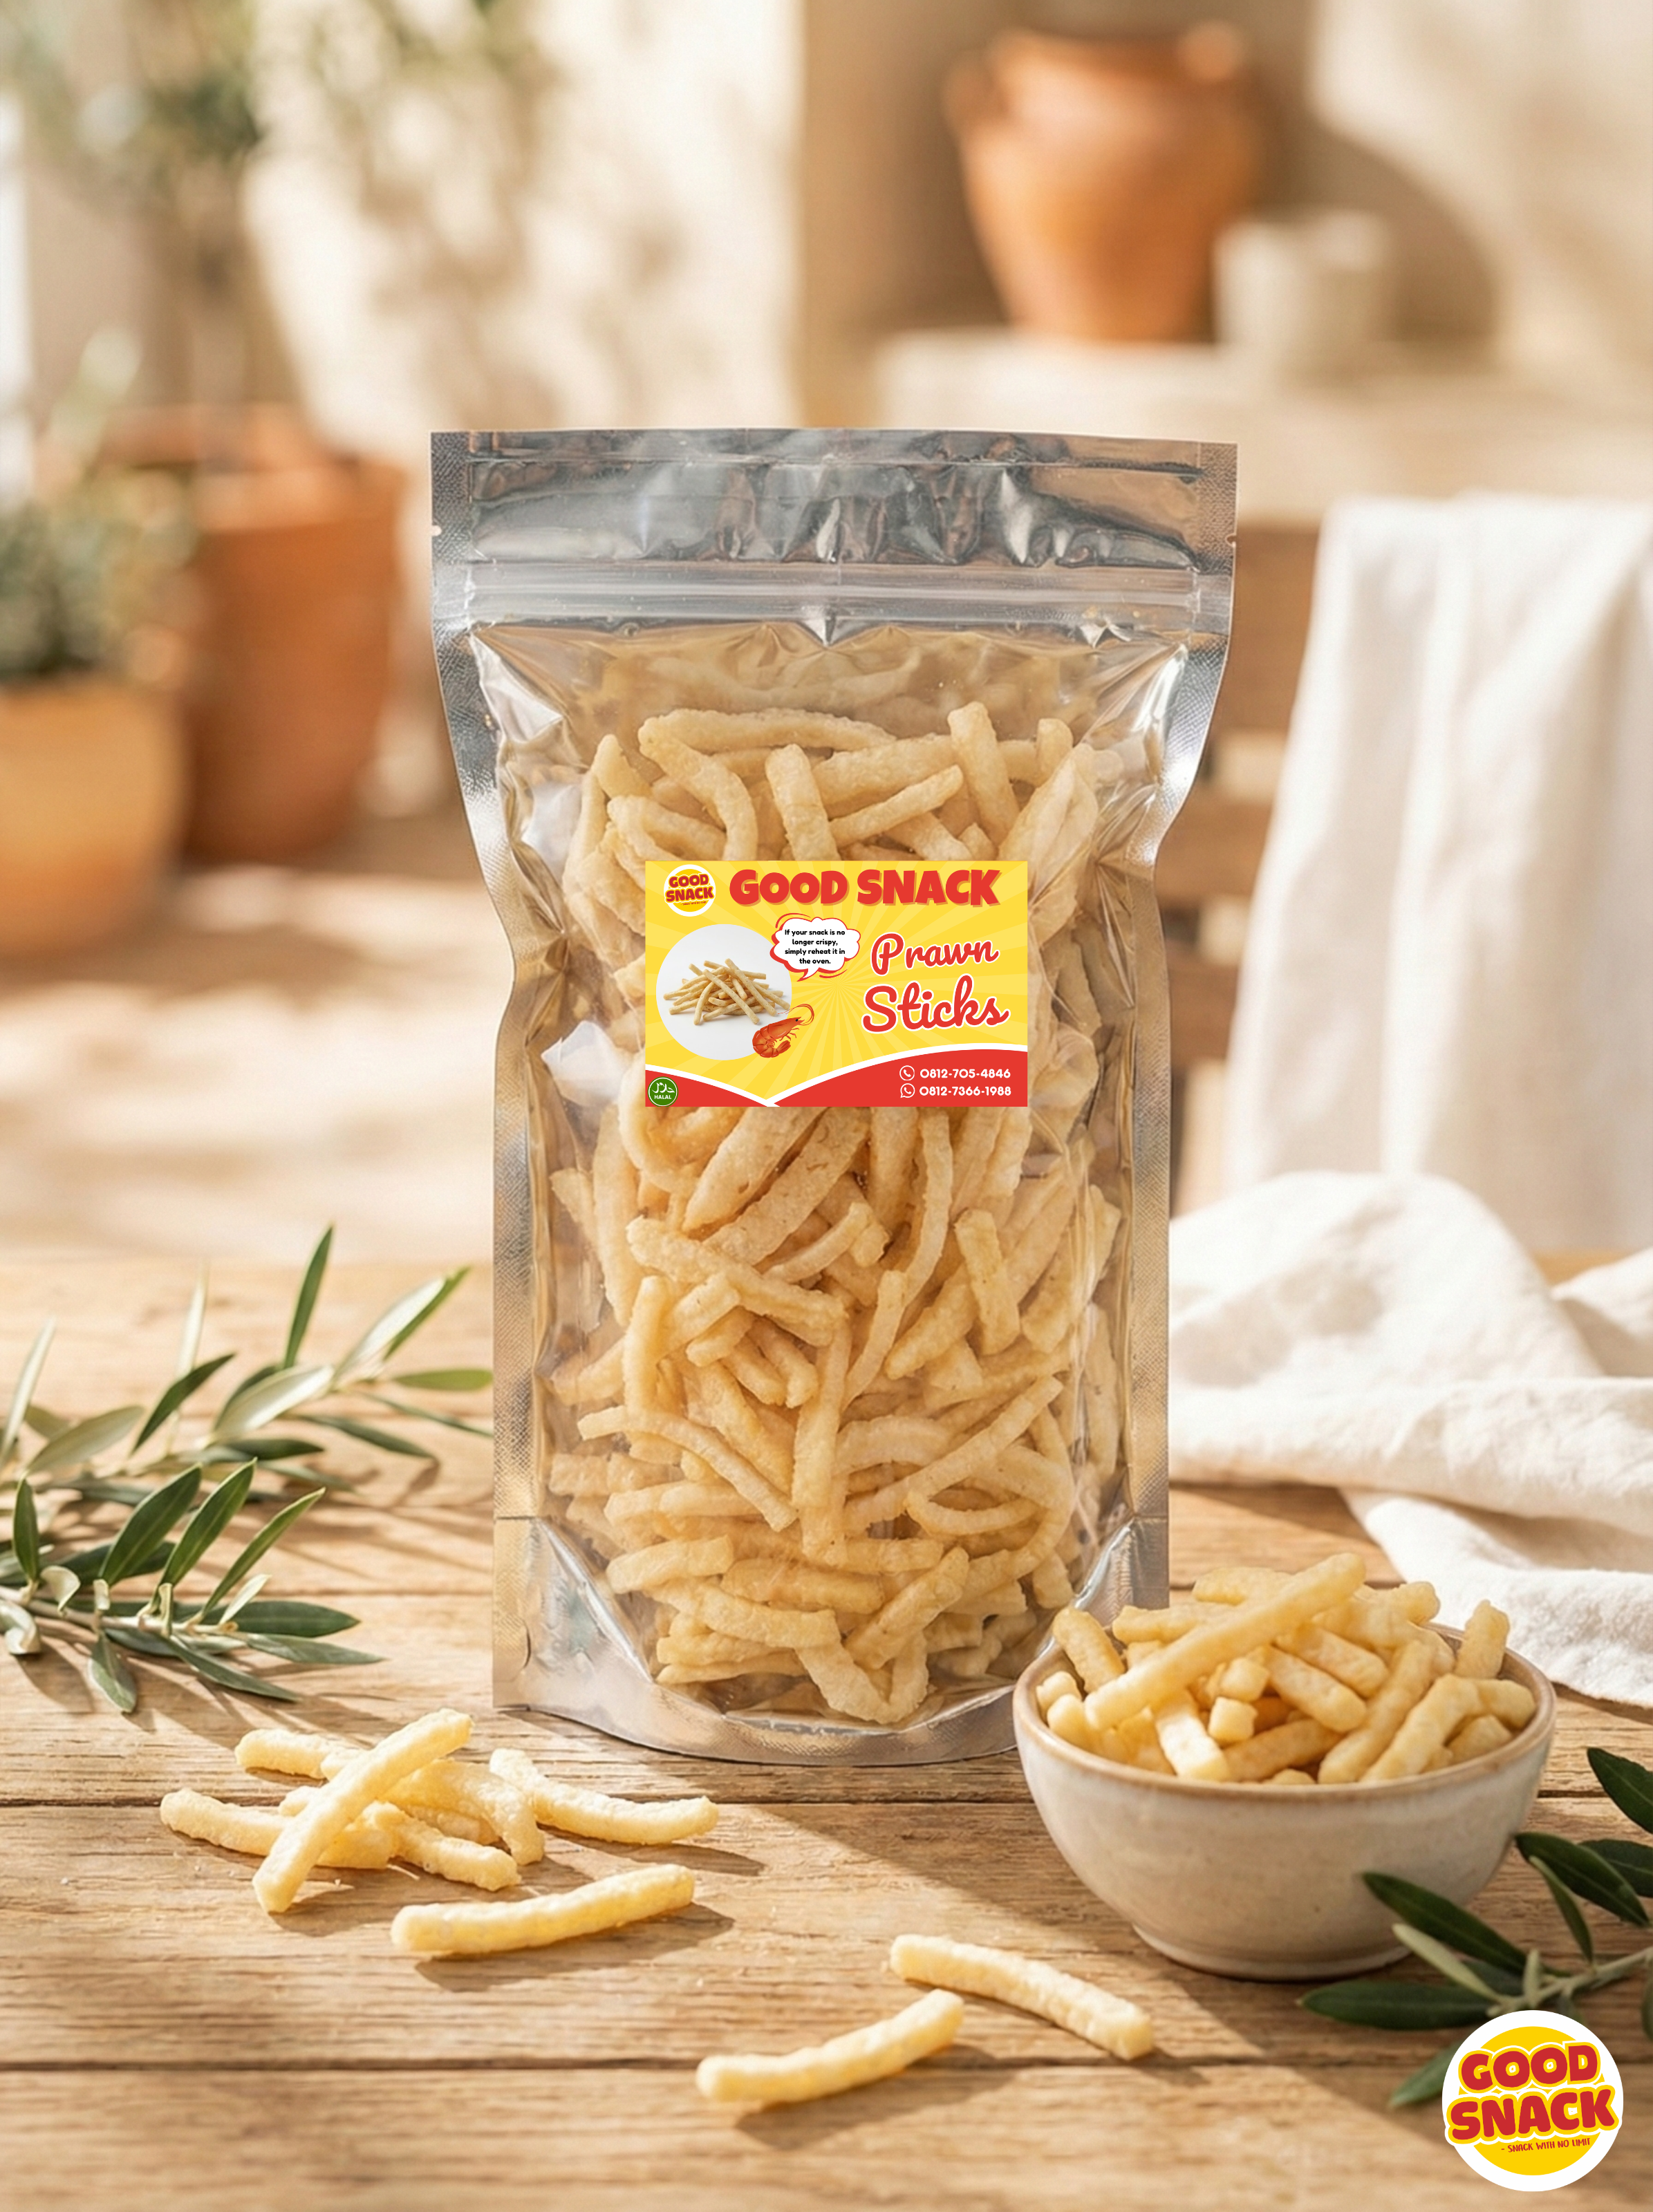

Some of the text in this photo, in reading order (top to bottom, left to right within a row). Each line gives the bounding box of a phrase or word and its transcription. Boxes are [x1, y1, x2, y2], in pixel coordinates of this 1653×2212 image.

[669, 874, 709, 888] GOOD
[729, 869, 1001, 907] GOOD SNACK
[666, 887, 714, 902] SNACK
[870, 932, 1000, 975] Prawn
[863, 975, 1010, 1033] Sticks
[919, 1069, 1011, 1078] 0812-705-4846
[919, 1087, 1011, 1096] 0812-7366-1988
